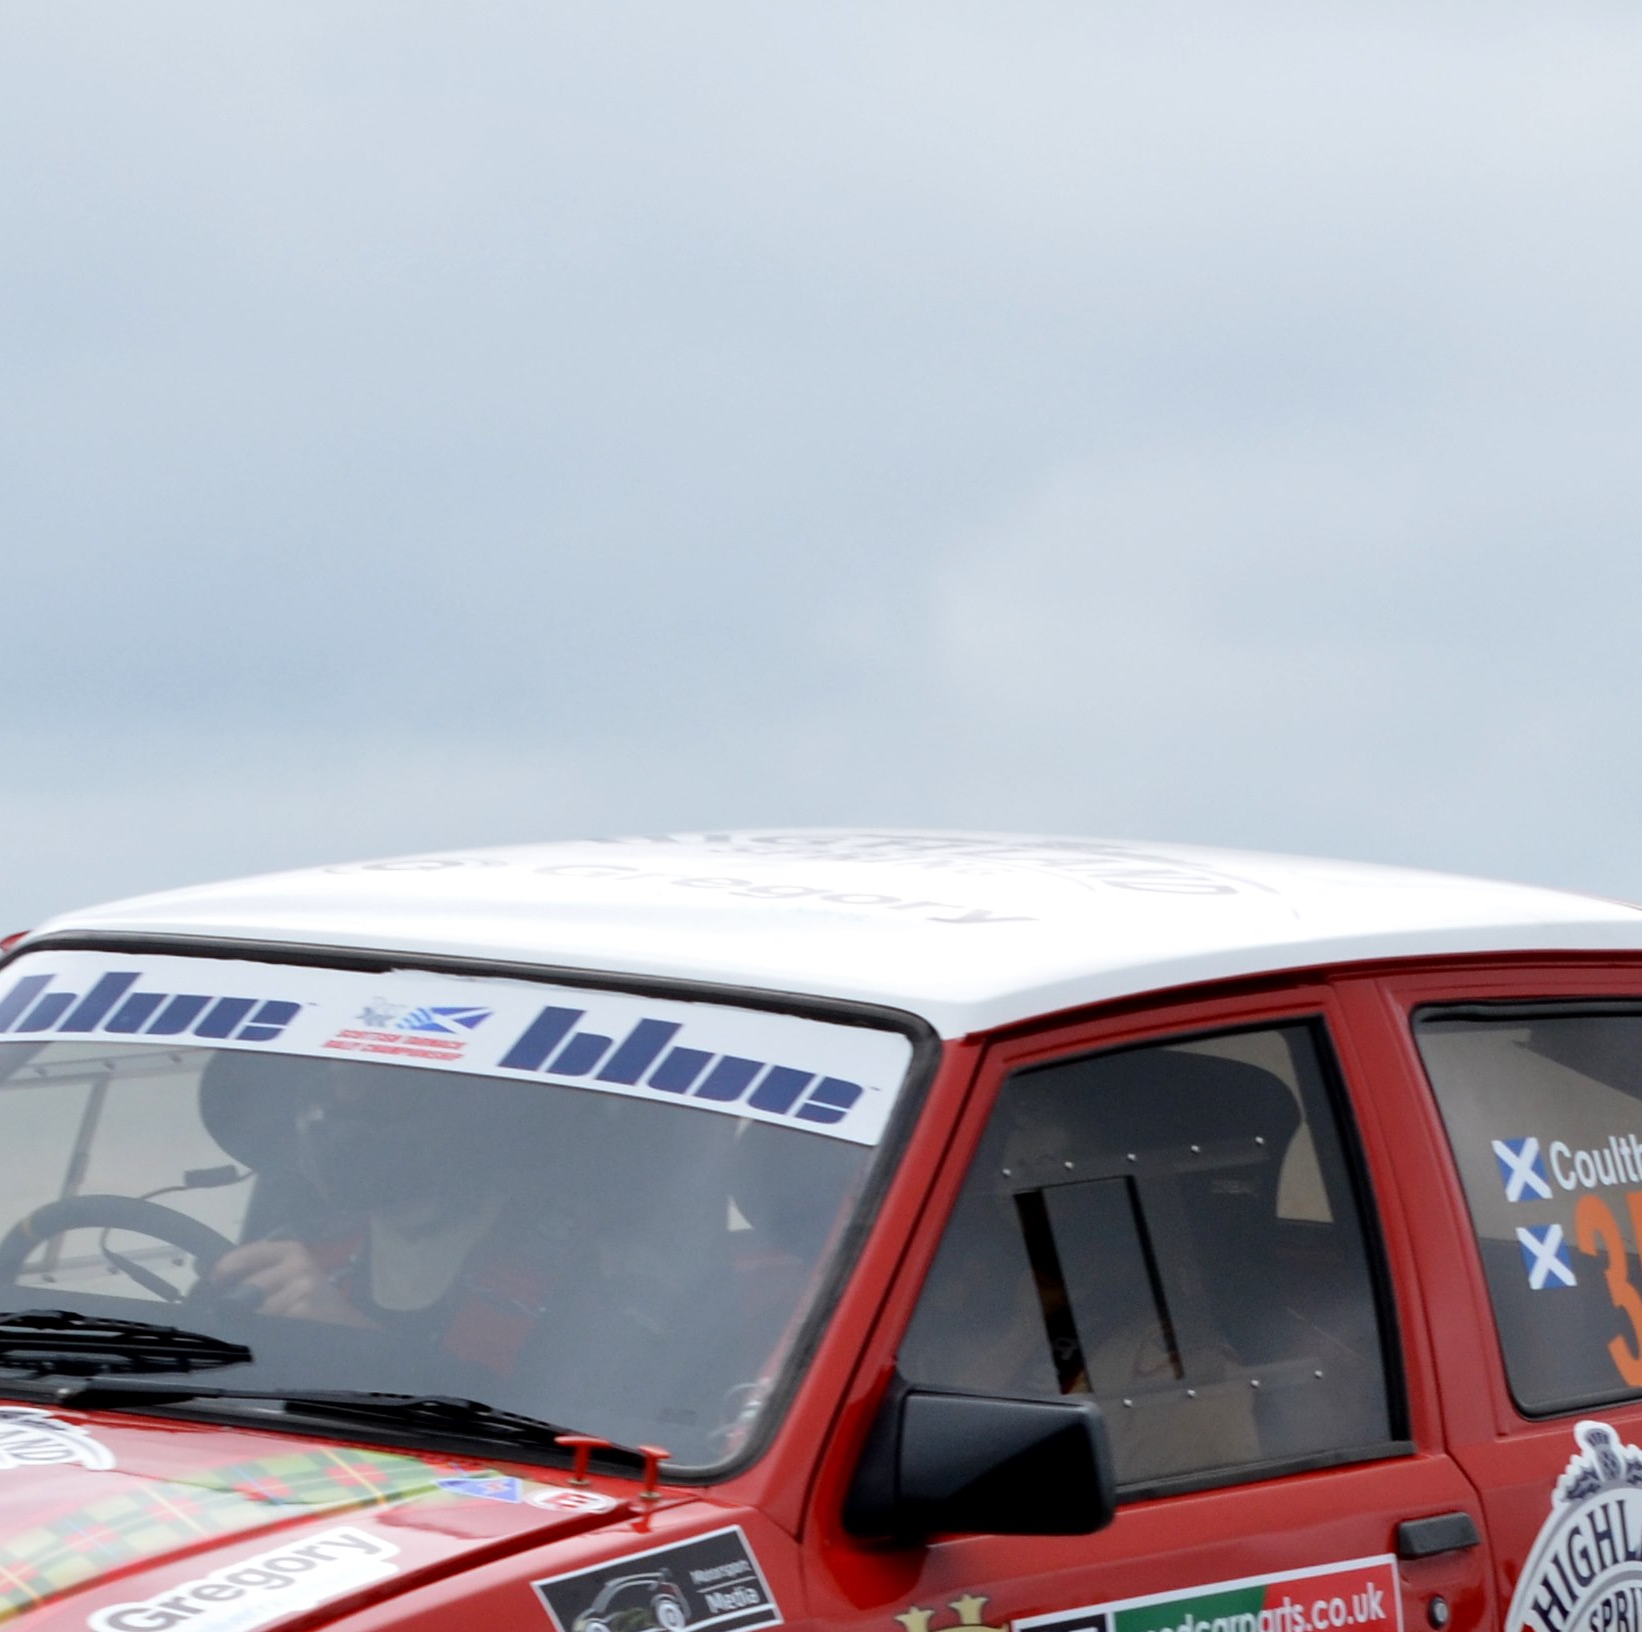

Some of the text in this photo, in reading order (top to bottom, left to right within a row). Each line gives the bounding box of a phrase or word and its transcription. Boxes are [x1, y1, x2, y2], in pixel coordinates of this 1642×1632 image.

[531, 864, 1041, 925] Gregory
[497, 1006, 865, 1125] blue
[705, 1586, 761, 1614] Media
